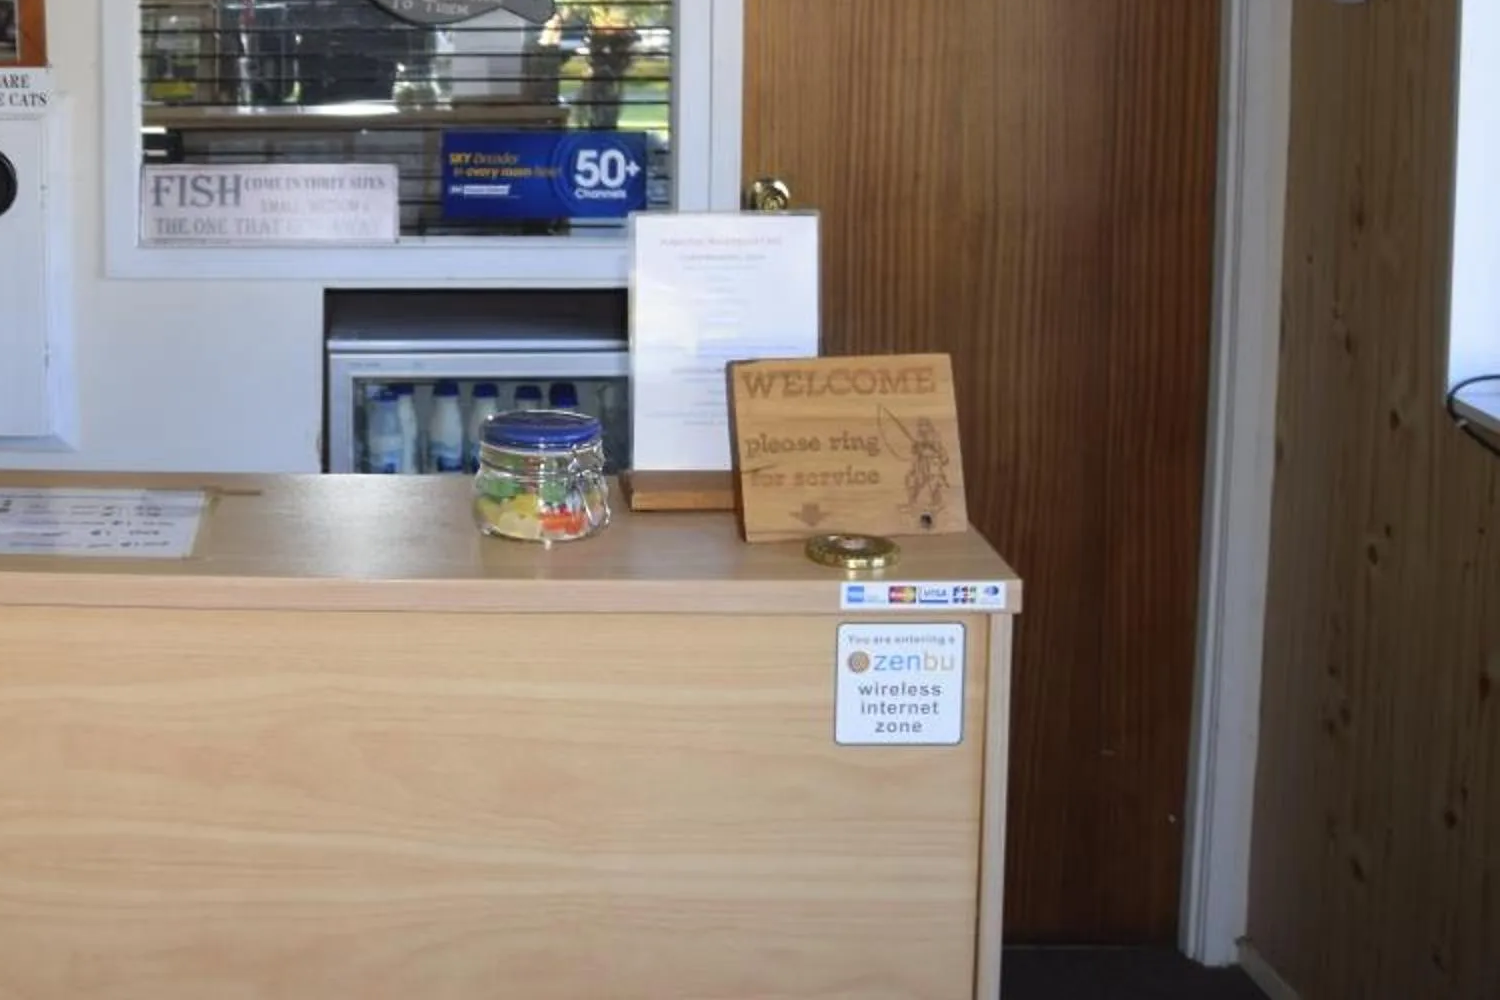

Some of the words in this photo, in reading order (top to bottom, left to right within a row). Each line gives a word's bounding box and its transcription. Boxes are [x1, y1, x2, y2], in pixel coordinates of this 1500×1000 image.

[9, 91, 49, 107] CATS
[574, 148, 641, 189] 50+
[151, 174, 243, 208] FISH
[574, 188, 628, 199] Channels
[153, 216, 191, 236] THE
[193, 217, 229, 236] ONE
[741, 366, 937, 399] WELCOME
[744, 432, 822, 459] please
[829, 430, 882, 457] ring
[793, 464, 881, 487] service
[848, 635, 870, 646] You
[873, 637, 891, 645] are
[894, 635, 946, 646] entering
[873, 651, 955, 672] zenbu
[857, 681, 943, 697] wireless
[860, 701, 940, 715] internet
[874, 720, 924, 734] zone
